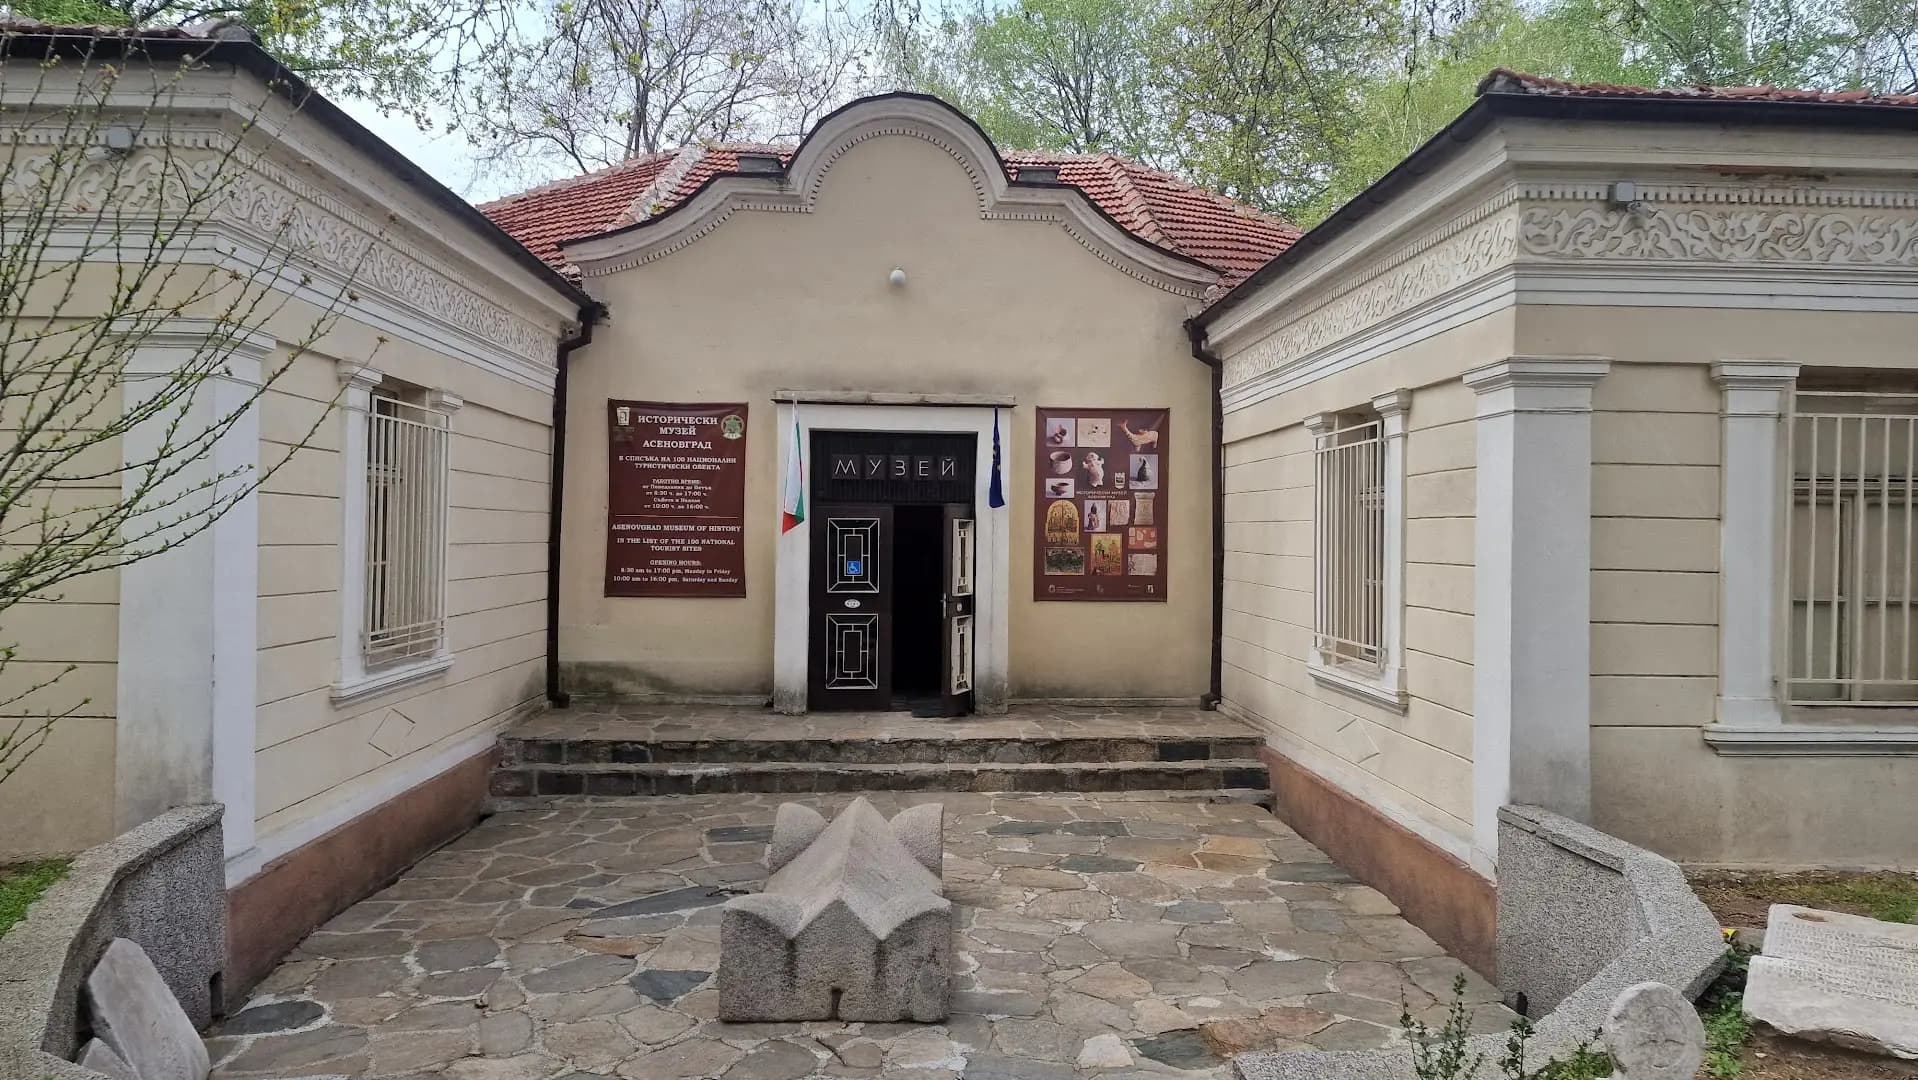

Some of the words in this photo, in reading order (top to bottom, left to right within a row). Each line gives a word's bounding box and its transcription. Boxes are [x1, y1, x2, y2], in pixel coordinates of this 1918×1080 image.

[638, 416, 718, 424] ИСТОРИЧЕСКИ
[660, 426, 696, 435] МУЗЕЙ
[642, 440, 712, 449] АСЕНОВГРАД
[834, 458, 955, 476] МУЗЕЙ
